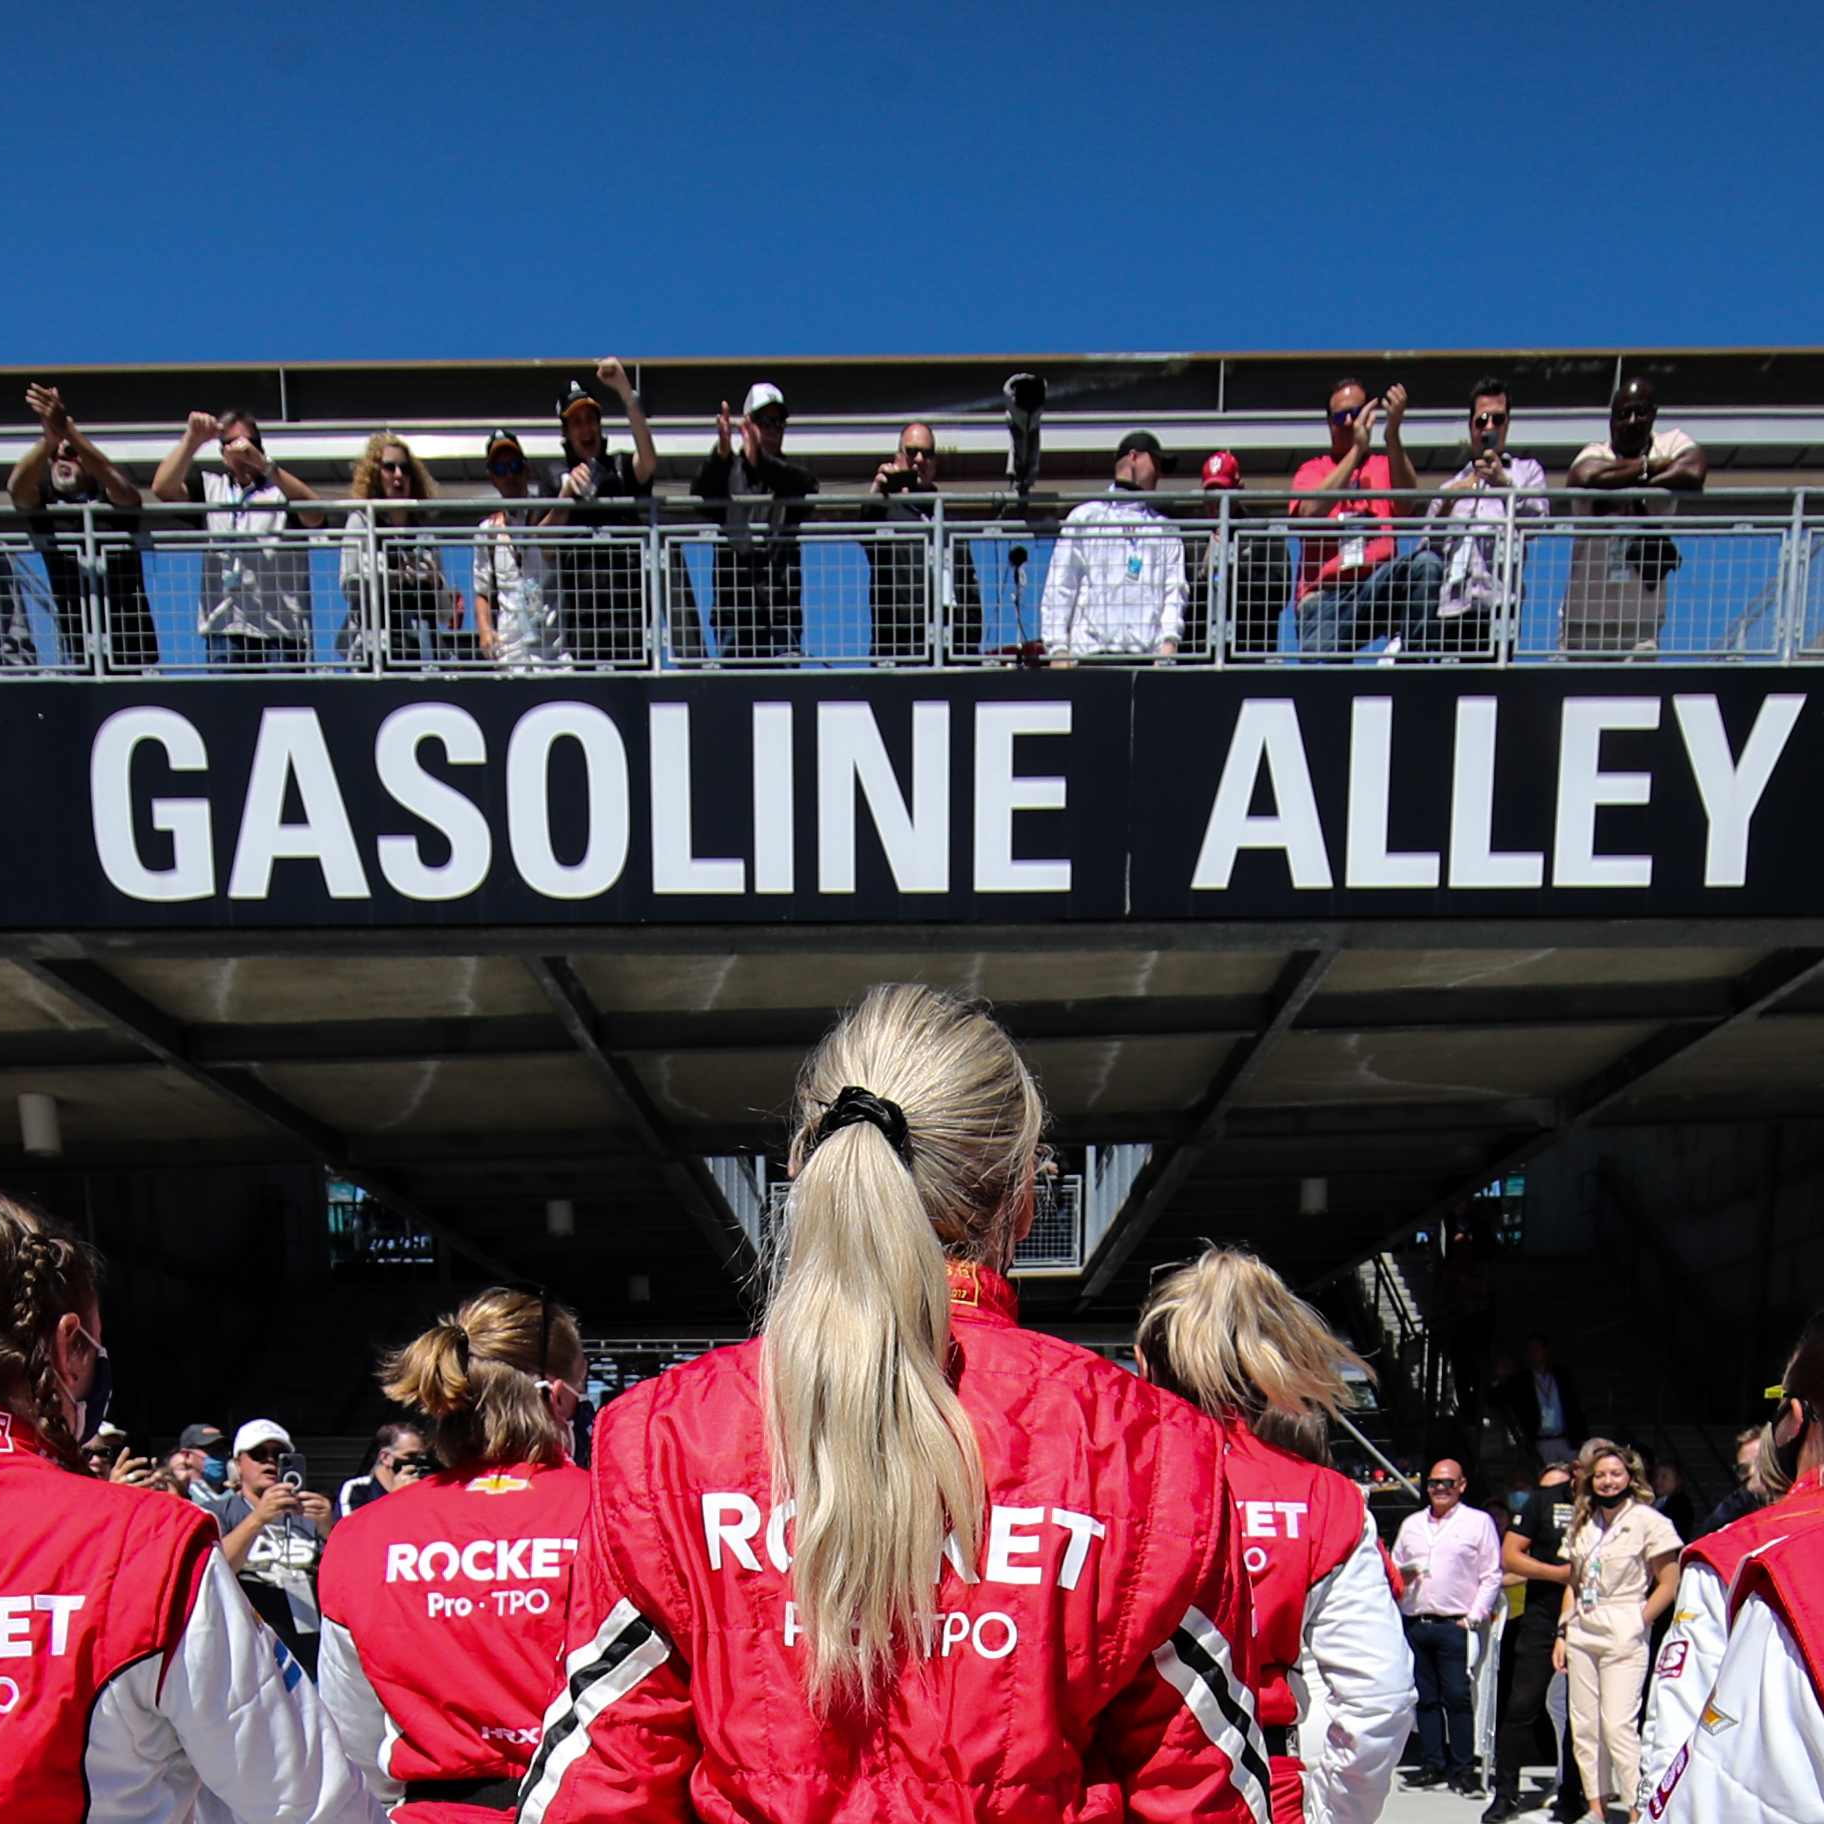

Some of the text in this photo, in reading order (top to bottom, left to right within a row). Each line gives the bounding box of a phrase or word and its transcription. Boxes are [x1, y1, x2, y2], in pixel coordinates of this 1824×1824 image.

[90, 694, 1806, 901] GASOLINE ALLEY
[702, 1492, 1106, 1591] RET
[427, 1588, 550, 1618] Pro TPO
[482, 1725, 540, 1745] HRX
